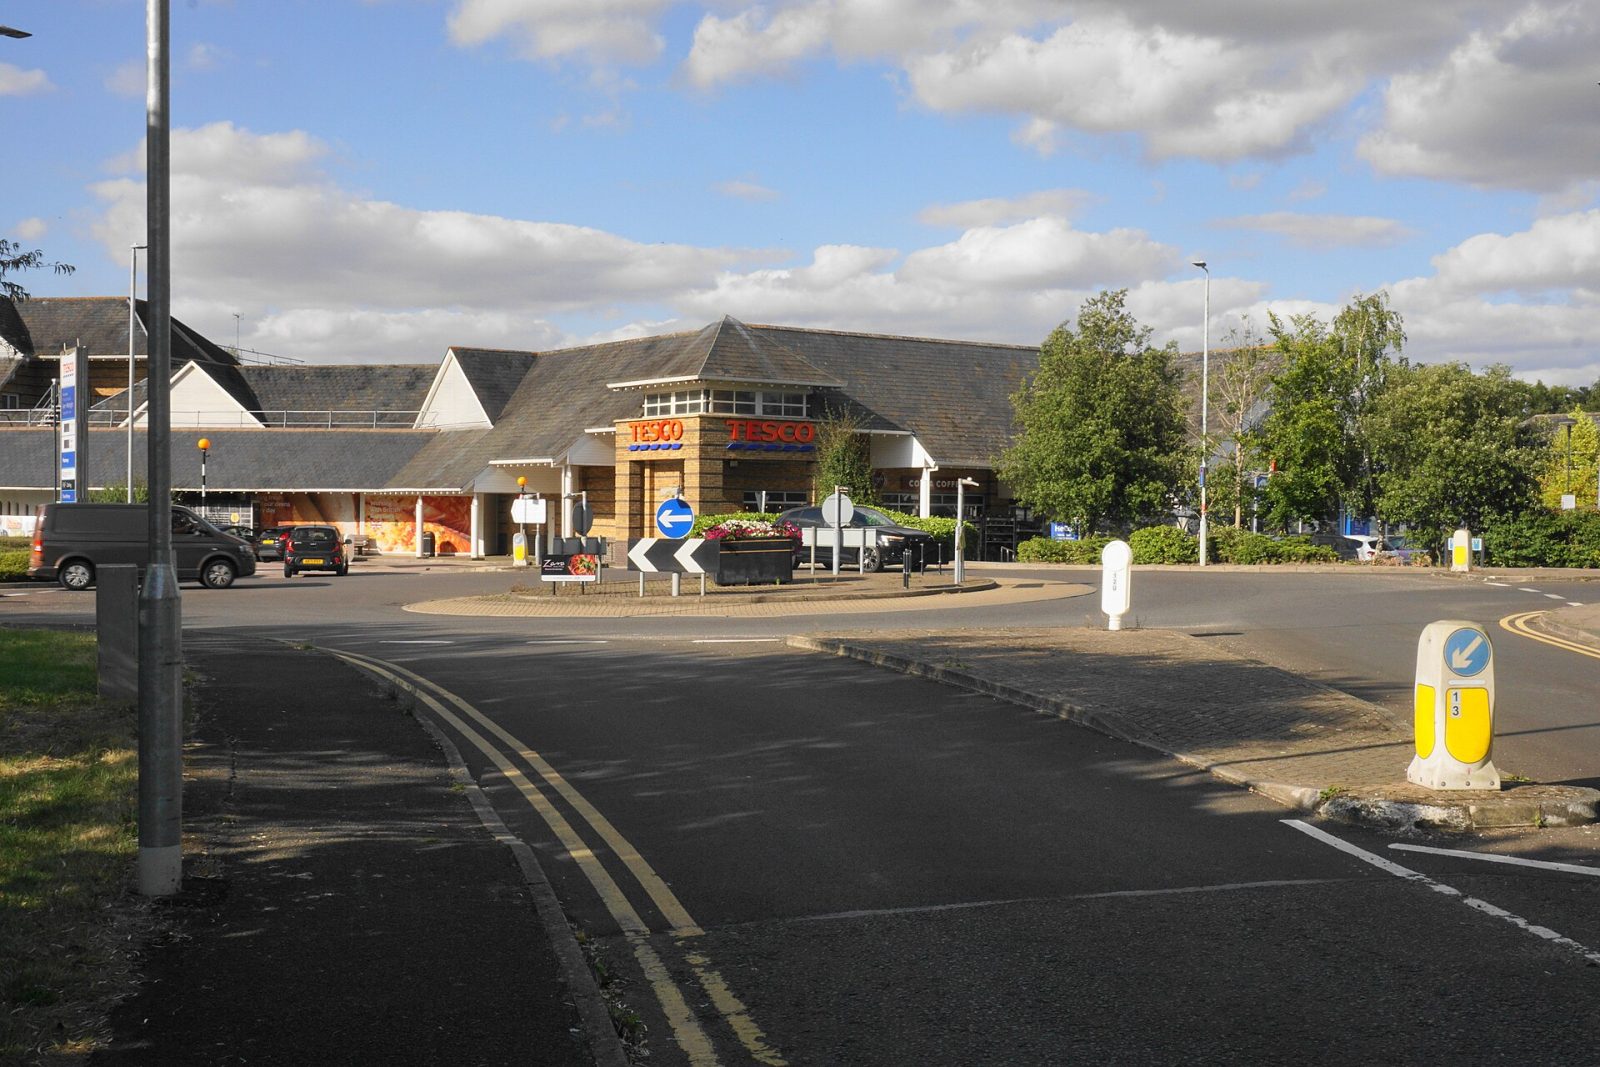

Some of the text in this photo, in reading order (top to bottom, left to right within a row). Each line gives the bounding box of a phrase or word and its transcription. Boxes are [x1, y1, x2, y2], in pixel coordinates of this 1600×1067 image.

[629, 420, 683, 442] TESCO
[725, 420, 816, 442] TESCO
[908, 479, 959, 489] COA COFFE
